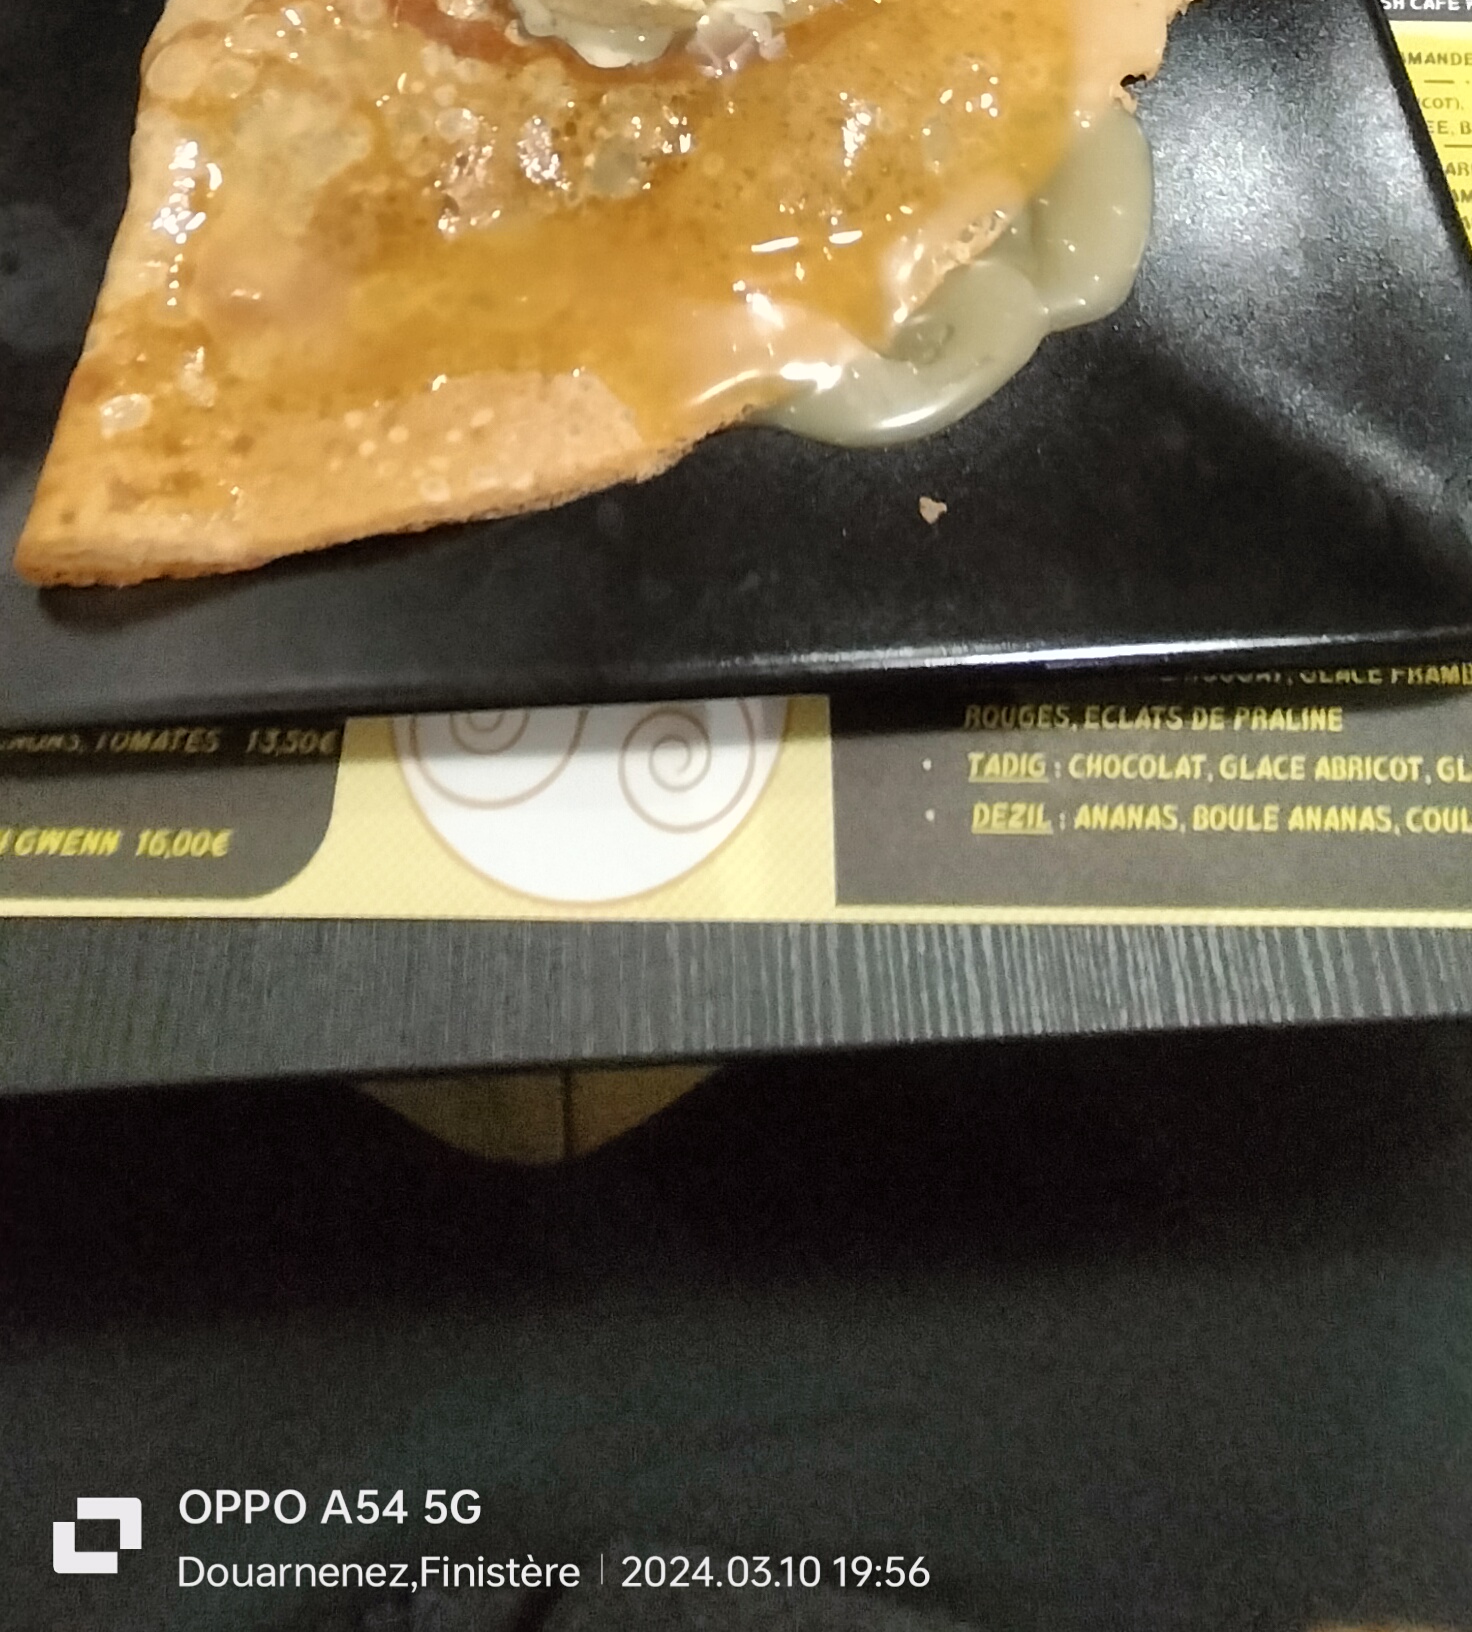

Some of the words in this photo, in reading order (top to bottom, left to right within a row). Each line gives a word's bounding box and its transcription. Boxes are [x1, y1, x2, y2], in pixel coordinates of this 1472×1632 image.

[1418, 97, 1464, 111] COT),
[964, 704, 1078, 732] ROUGES,
[1084, 705, 1184, 731] ECLATS
[1191, 706, 1225, 731] DE
[1233, 706, 1343, 732] PRALINE
[967, 752, 1049, 783] TADIG
[1068, 753, 1213, 783] CHOCOLAT,
[1219, 754, 1306, 781] GLACE
[1314, 755, 1432, 785] ABRICOT,
[971, 802, 1053, 835] DEZIL
[1074, 803, 1186, 834] ANANAS,
[1193, 804, 1280, 832] BOULE
[1288, 805, 1401, 837] ANANAS,
[14, 827, 120, 856] GWENN
